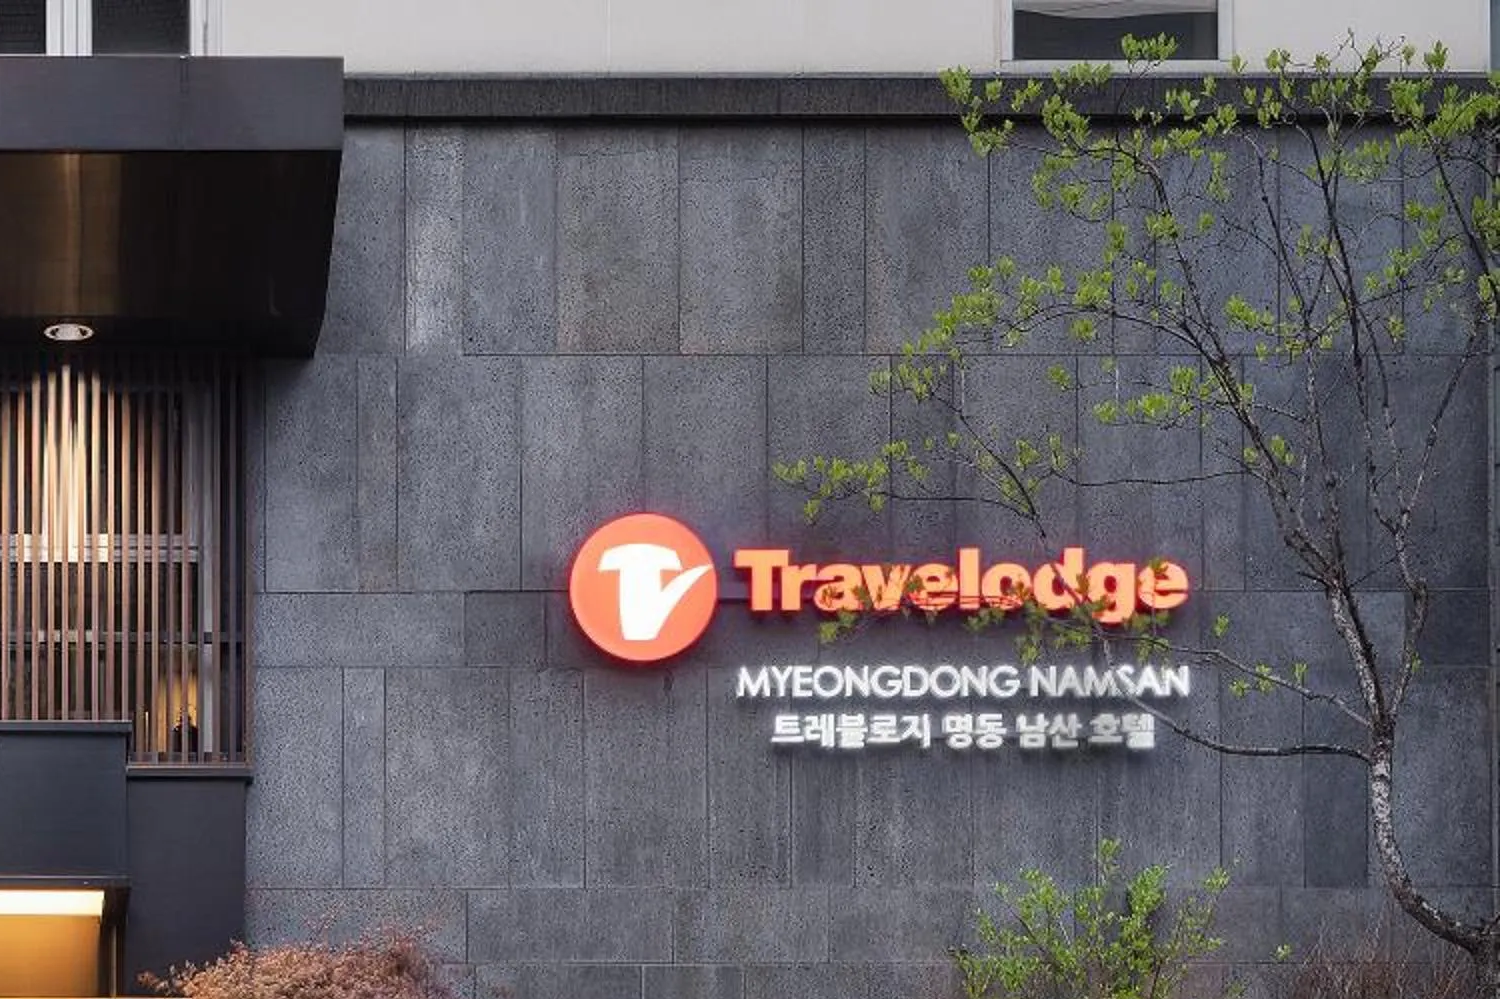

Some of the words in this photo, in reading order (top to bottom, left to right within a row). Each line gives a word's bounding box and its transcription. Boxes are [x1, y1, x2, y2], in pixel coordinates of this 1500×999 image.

[734, 547, 1189, 624] Travelodge
[736, 665, 1021, 697] MYEONGDONG
[1029, 665, 1190, 697] NAMSAN
[771, 713, 931, 748] 트레블로지
[942, 713, 1007, 749] 명동
[1015, 713, 1082, 748] 남산
[1088, 713, 1155, 748] 호텔
